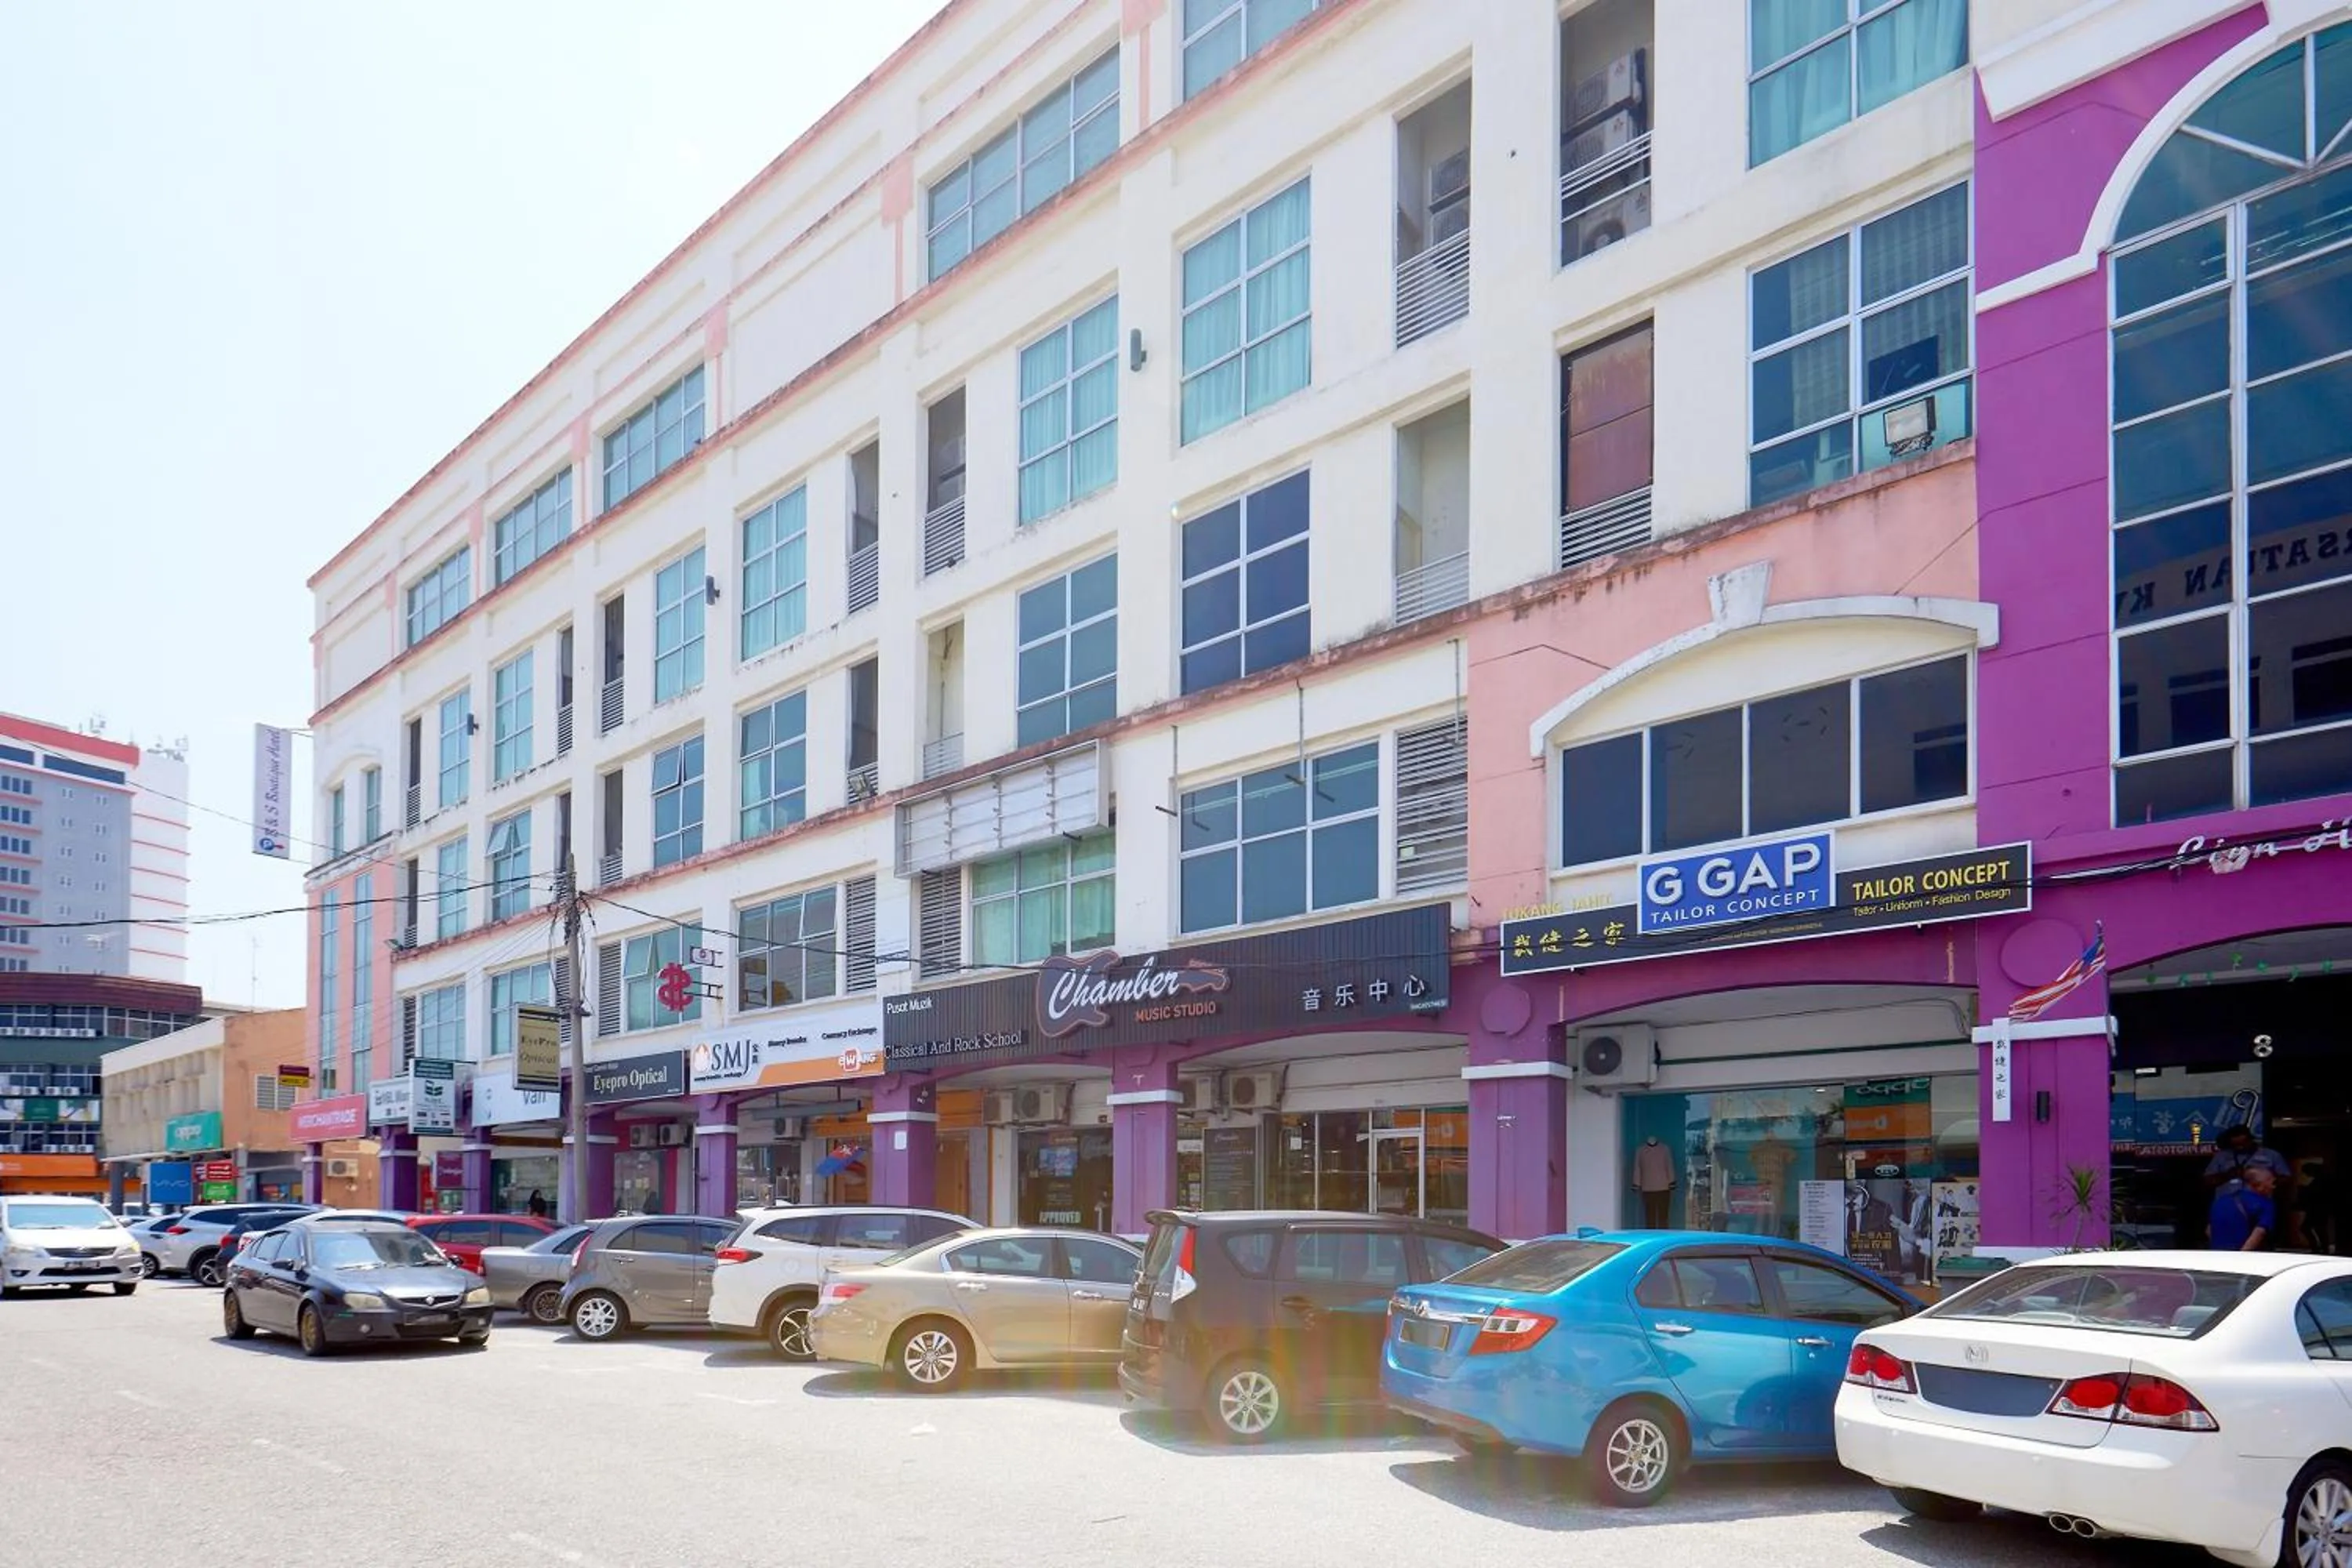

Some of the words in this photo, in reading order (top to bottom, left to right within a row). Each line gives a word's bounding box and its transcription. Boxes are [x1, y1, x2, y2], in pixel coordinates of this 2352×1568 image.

[1646, 866, 1683, 906] G
[1697, 843, 1821, 897] GAP
[1852, 875, 1915, 901] TAILOR
[1922, 860, 2011, 891] CONCEPT
[1651, 904, 1716, 924] TAILOR
[1727, 888, 1820, 914] CONCEPT
[1853, 905, 1877, 917] Tailor
[1885, 898, 1923, 913] Uniform
[1932, 892, 1971, 906] Fashion
[1975, 887, 2011, 902] Design
[1048, 956, 1180, 1020] Chamber
[1301, 975, 1425, 1011] 音乐中心
[887, 1001, 908, 1014] Pusat
[1136, 1004, 1171, 1022] MUSIC
[1172, 1001, 1216, 1018] STUDIO
[711, 1039, 751, 1076] SMJ
[884, 1042, 927, 1059] Classical
[930, 1038, 951, 1055] And
[954, 1035, 981, 1053] Rock
[984, 1029, 1022, 1048] School
[2252, 1034, 2274, 1058] 8
[593, 1074, 628, 1094] Eyepro
[630, 1065, 667, 1091] Optical
